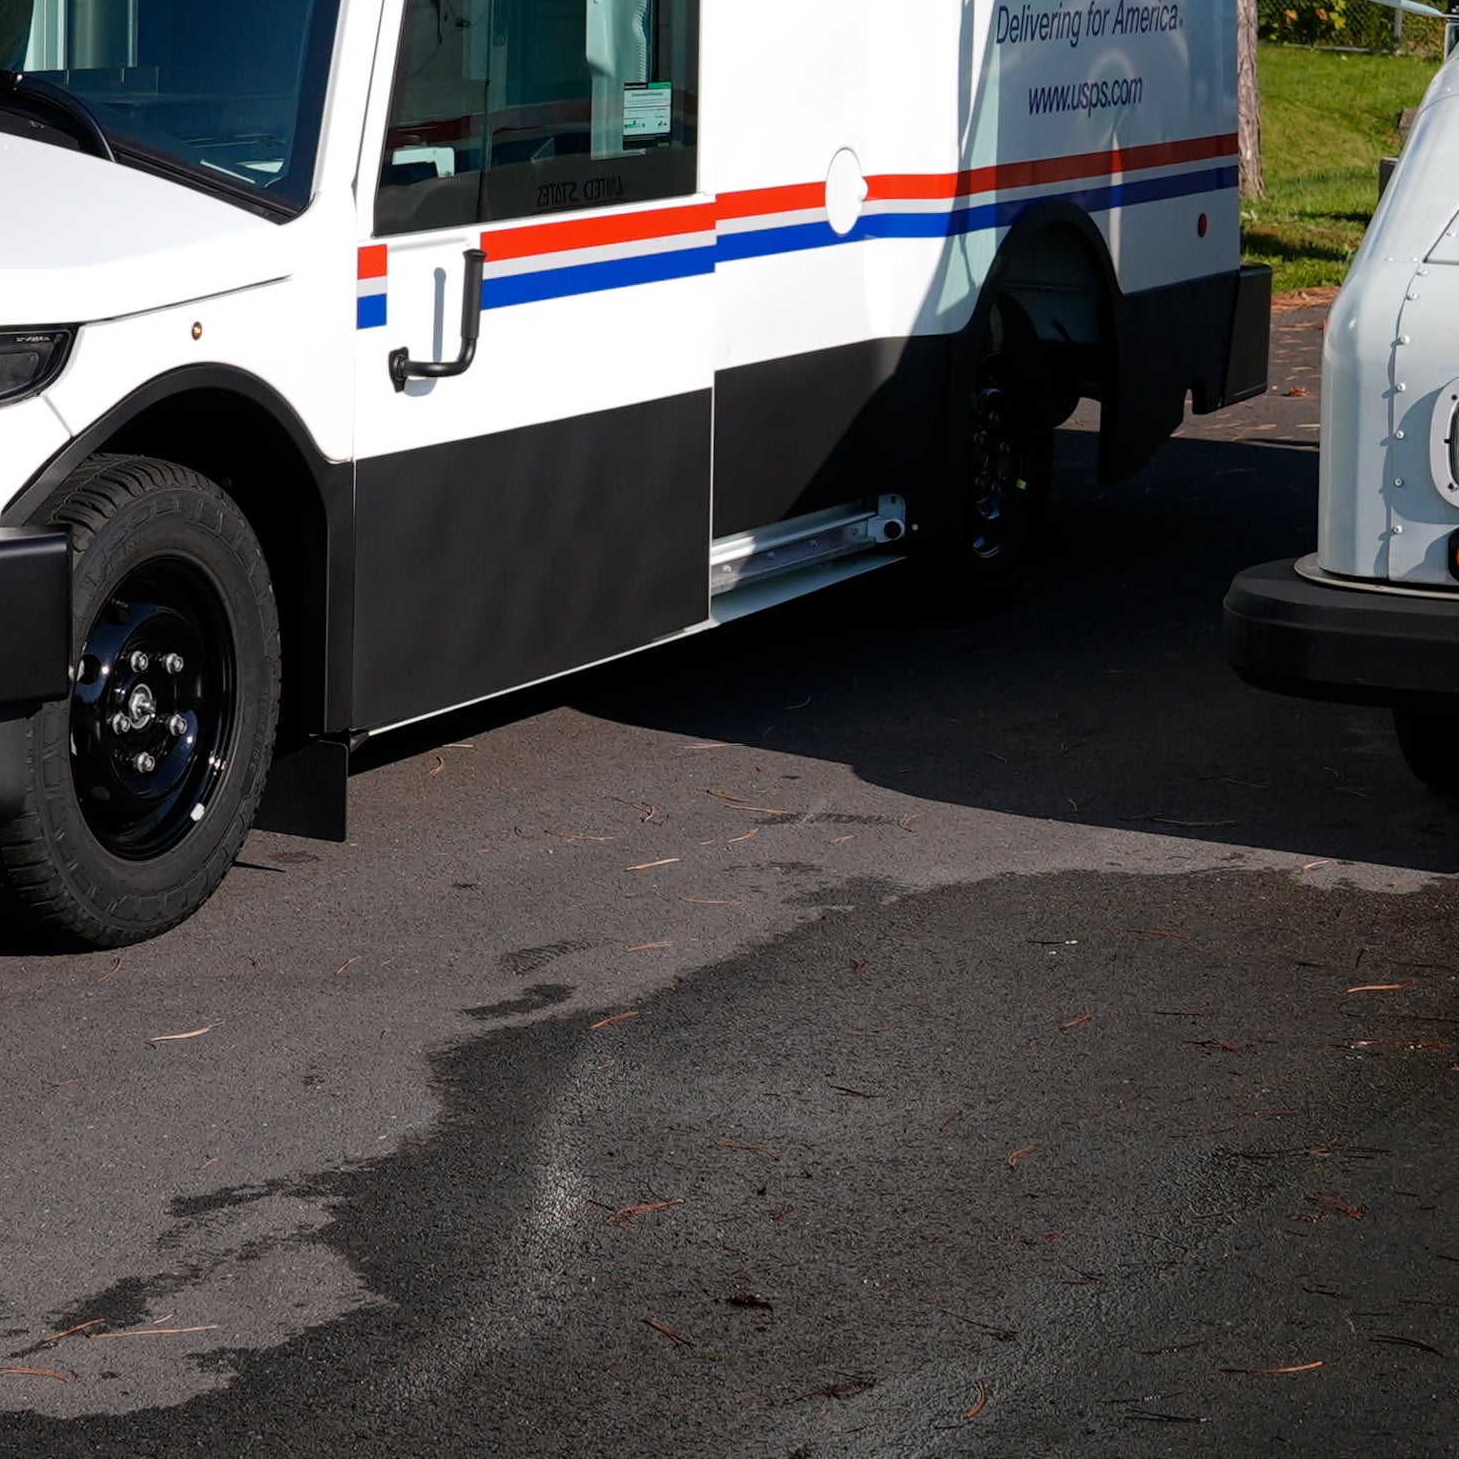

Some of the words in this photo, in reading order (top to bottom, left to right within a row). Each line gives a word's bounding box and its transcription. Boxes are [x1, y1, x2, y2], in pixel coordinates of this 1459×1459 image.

[996, 2, 1082, 47] Delivering
[1086, 0, 1110, 37] for
[1028, 76, 1143, 117] www.usps.com
